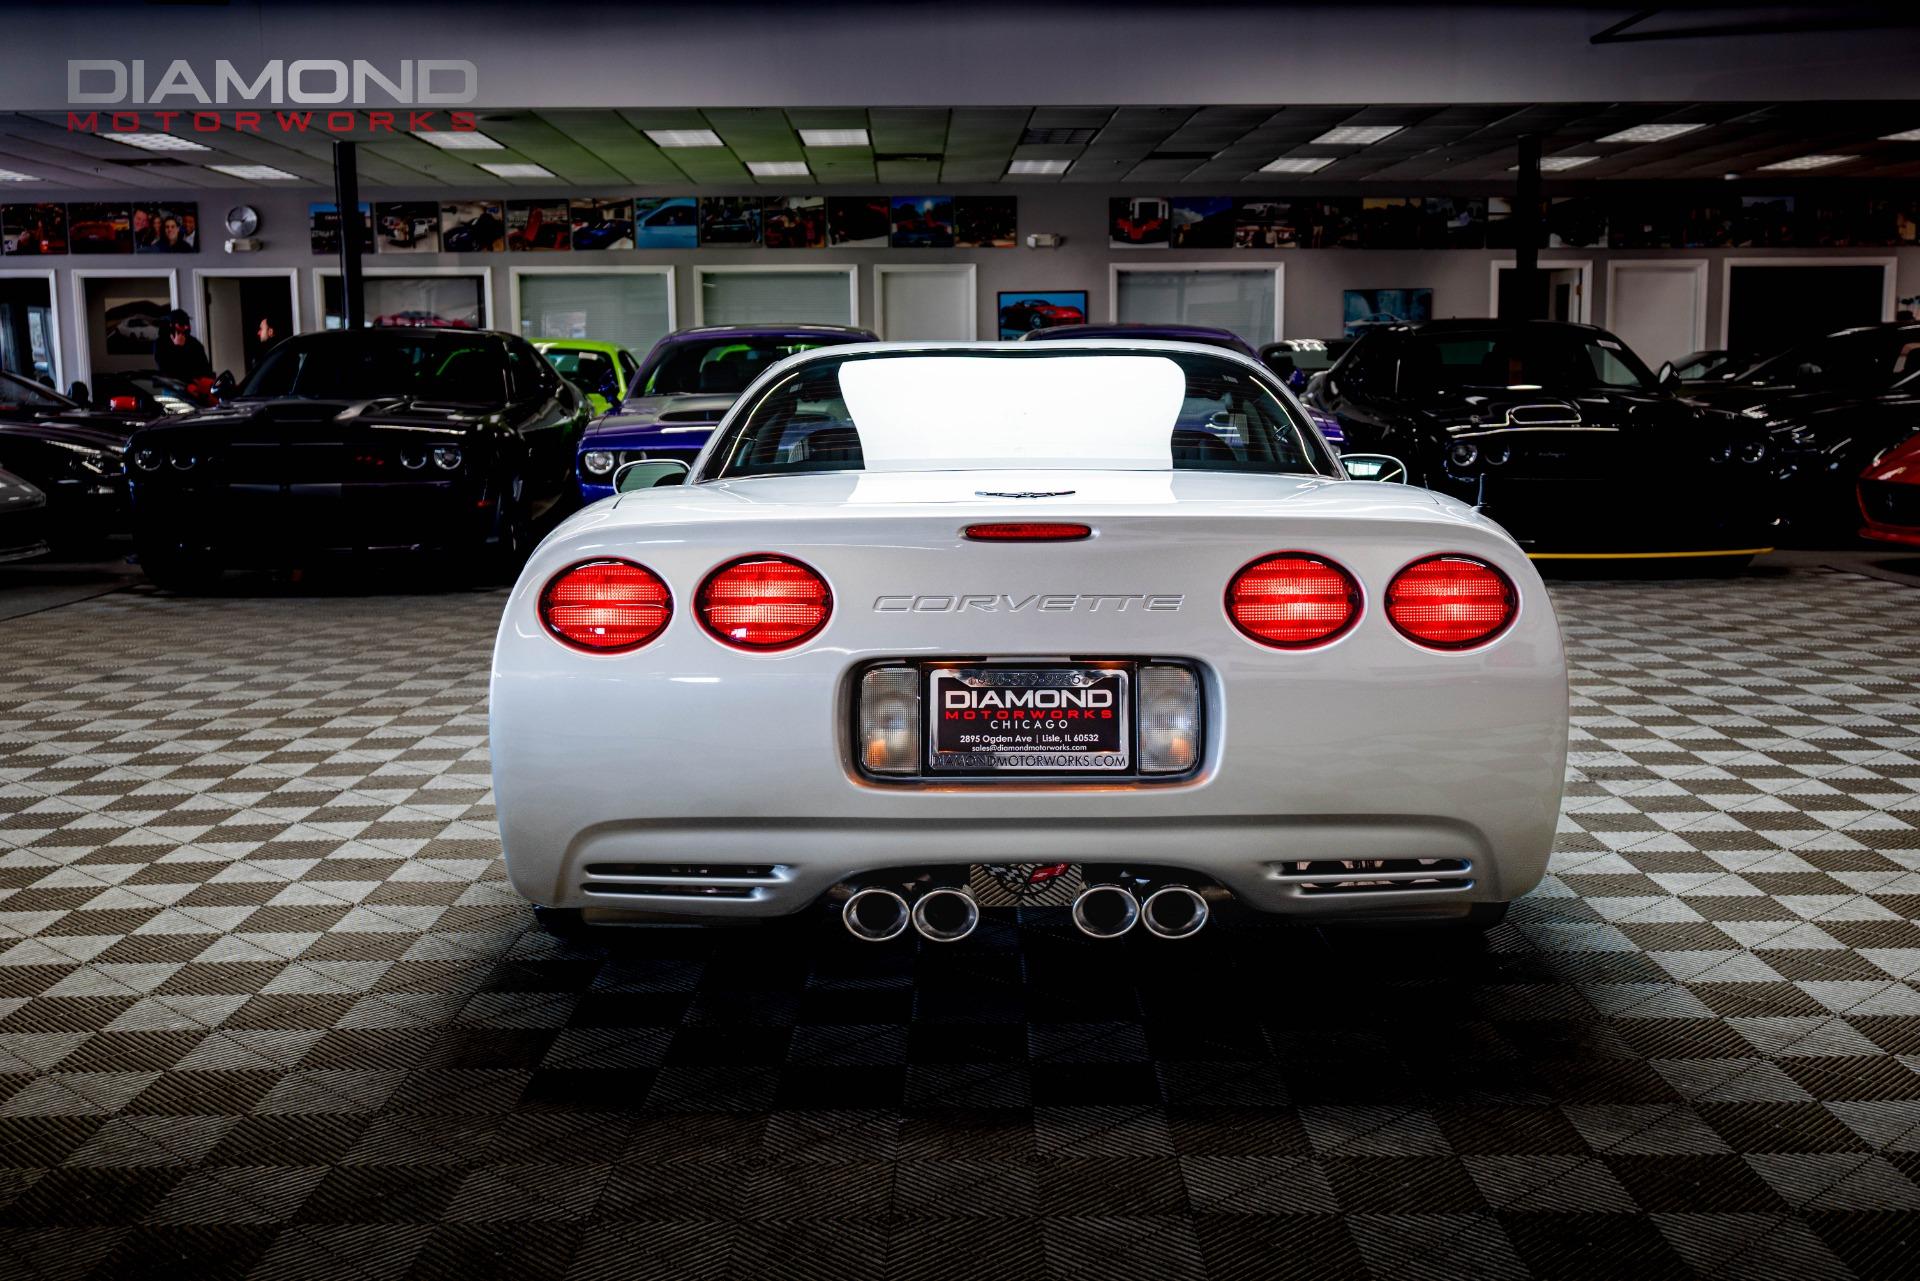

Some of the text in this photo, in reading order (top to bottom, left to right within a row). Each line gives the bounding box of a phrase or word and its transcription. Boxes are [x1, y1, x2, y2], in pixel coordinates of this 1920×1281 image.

[872, 594, 1185, 613] CORVETTE
[945, 689, 1113, 709] DIAMOND
[945, 709, 1113, 720] MOTORWORKS
[990, 719, 1069, 730] CHICAGO
[959, 735, 981, 743] 2895
[982, 734, 1013, 745] Ogden
[1015, 734, 1032, 742] Ave
[1042, 733, 1062, 743] Lisle,
[1064, 734, 1071, 742] IL
[1073, 733, 1099, 742] 60532
[971, 743, 1087, 752] sales@diamondmotorworks.com
[932, 754, 1127, 767] DIAMONDMOTORWORKS.COM
